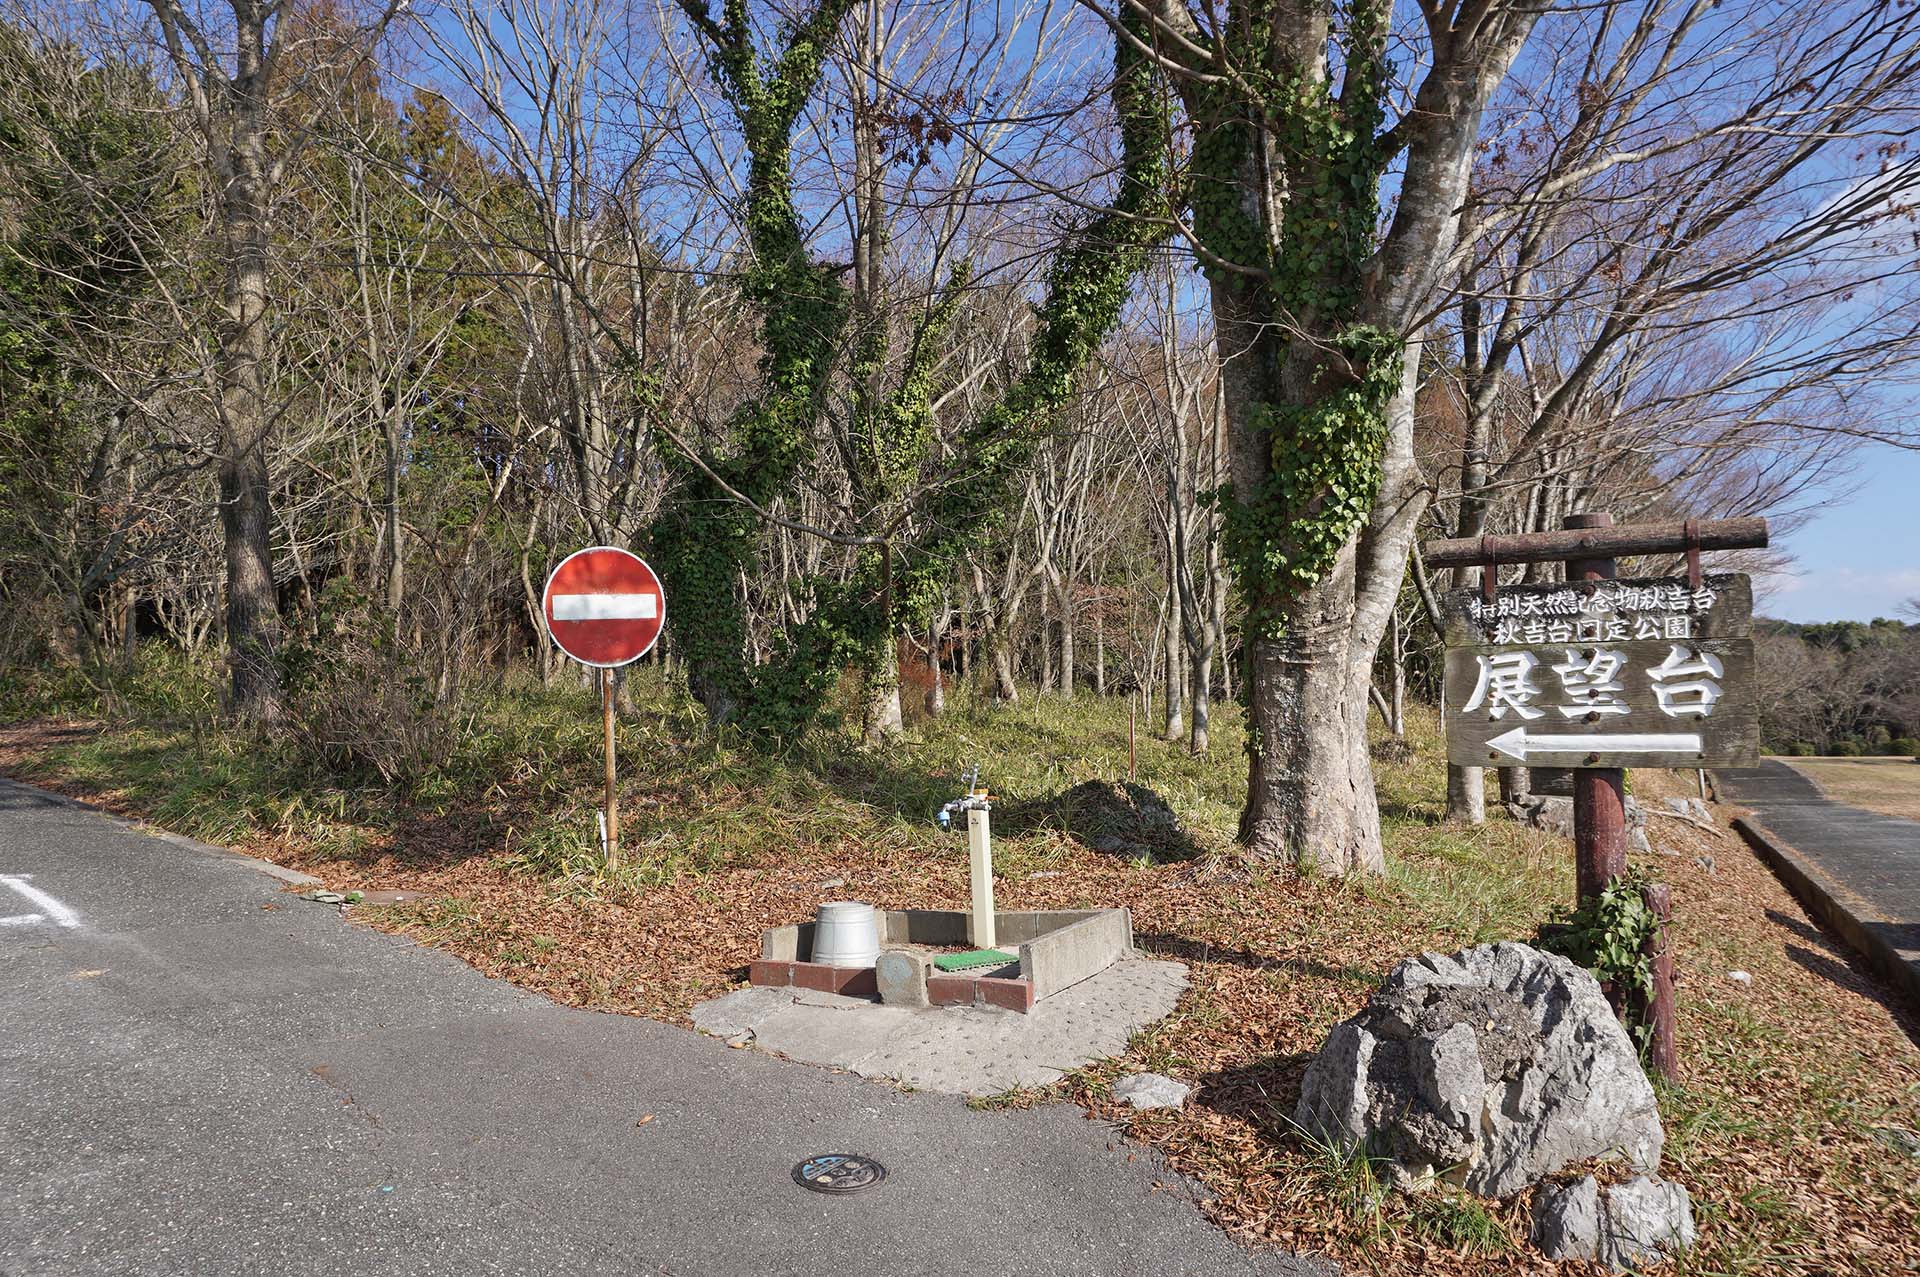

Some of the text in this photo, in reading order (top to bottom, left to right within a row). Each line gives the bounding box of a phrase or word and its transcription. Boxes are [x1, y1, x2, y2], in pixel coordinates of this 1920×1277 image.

[1470, 586, 1717, 618] 特別天然記念物秋吉台
[1493, 615, 1690, 644] 秋吉台国定公園
[1462, 645, 1724, 719] 展望台
